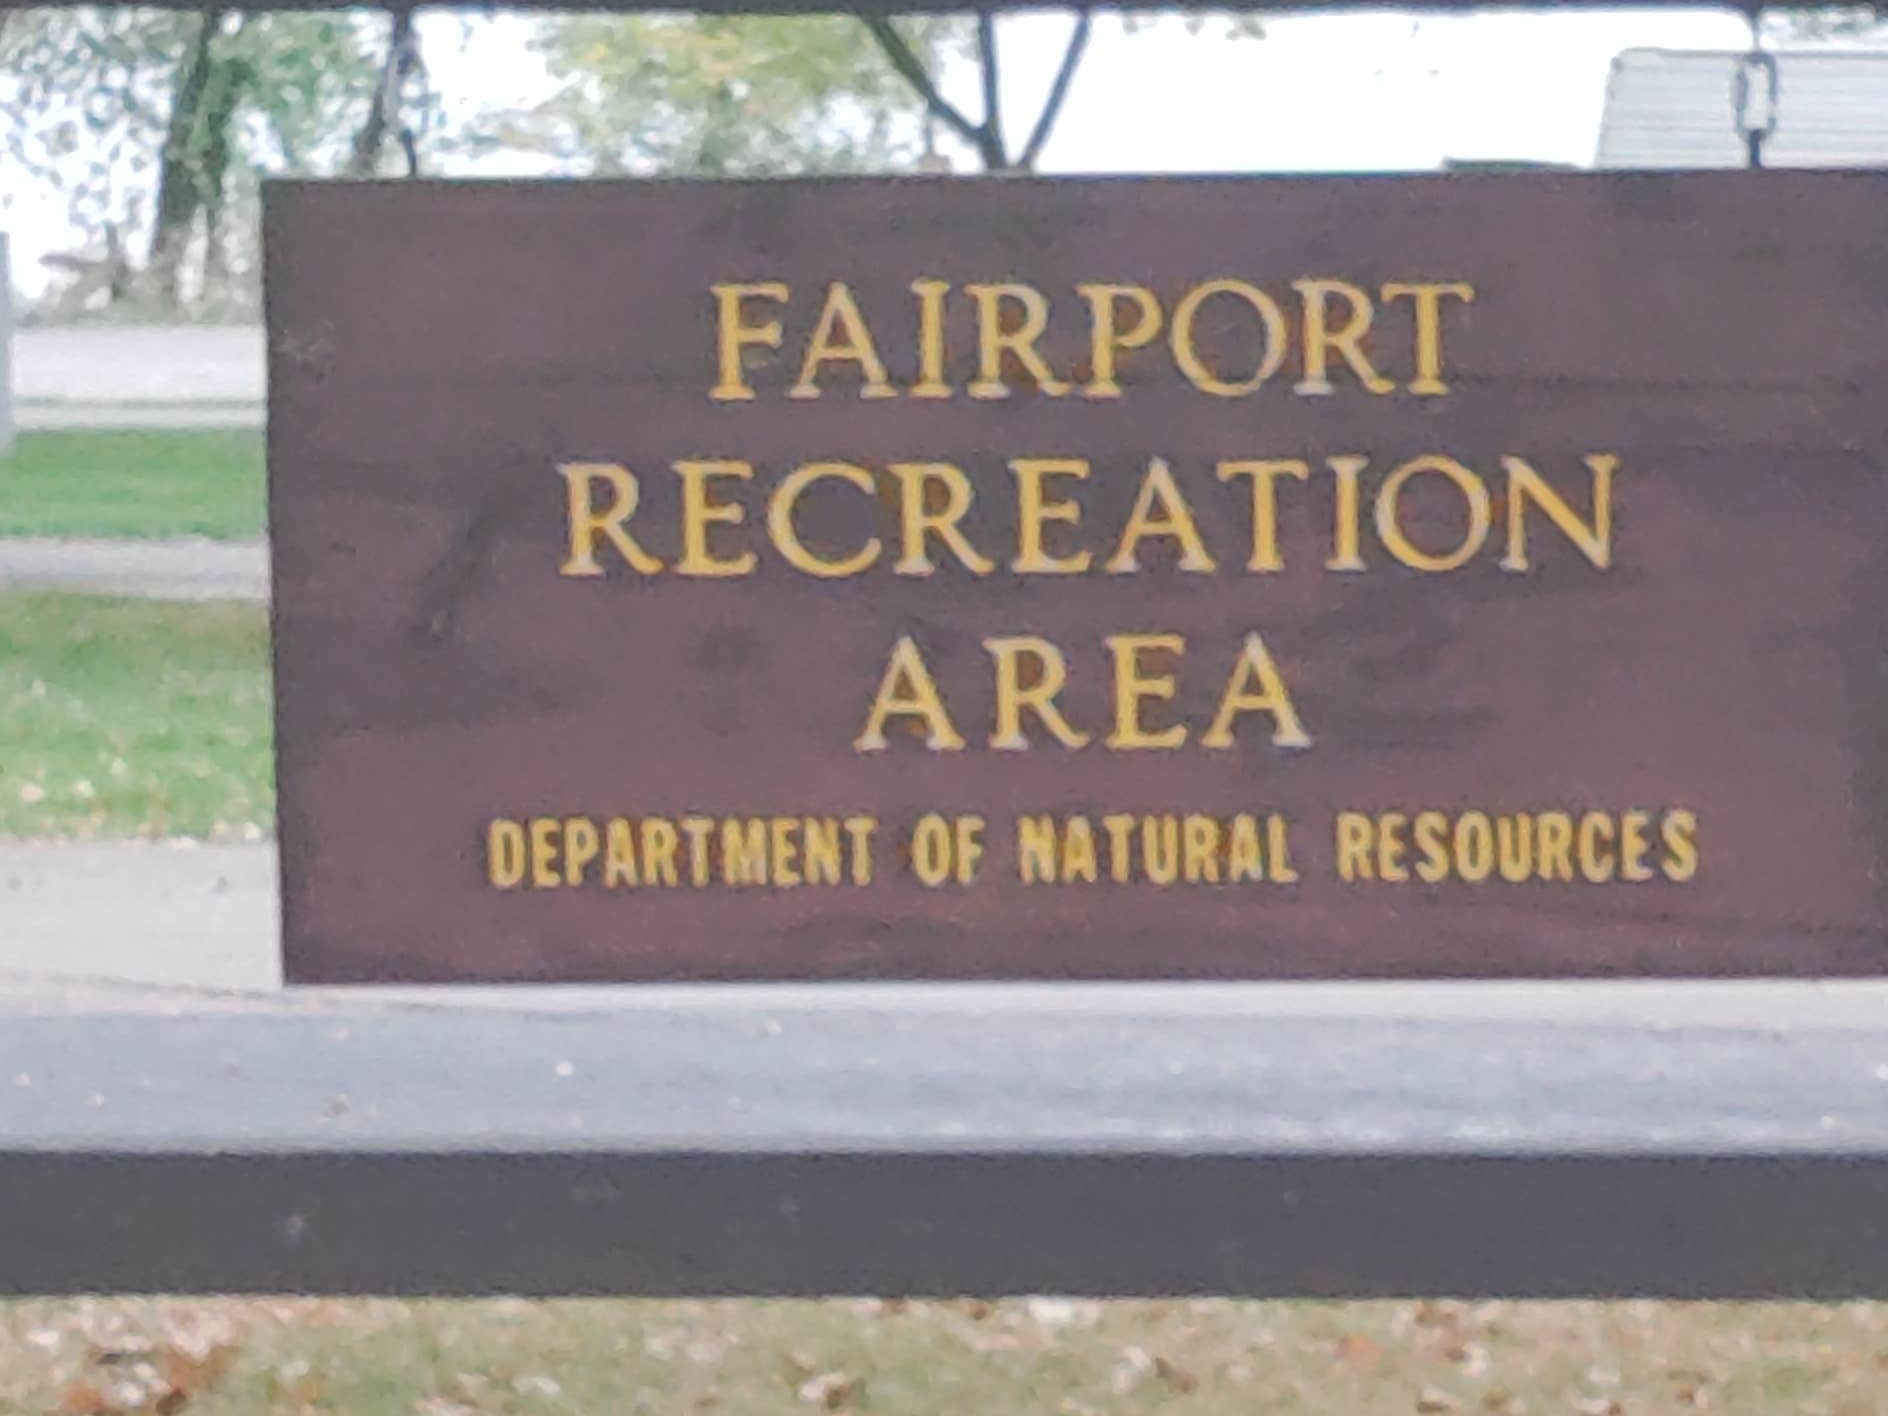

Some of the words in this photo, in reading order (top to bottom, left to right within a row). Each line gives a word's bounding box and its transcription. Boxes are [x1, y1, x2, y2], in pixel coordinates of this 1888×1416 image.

[710, 278, 1476, 402] FAIRPORT
[558, 452, 1618, 579] RECREATION
[853, 633, 1313, 753] AREA
[487, 818, 878, 889] DEPARTMENT
[911, 815, 986, 886] OF
[1017, 813, 1298, 886] NATURAL
[1336, 807, 1700, 884] RESOURCES
